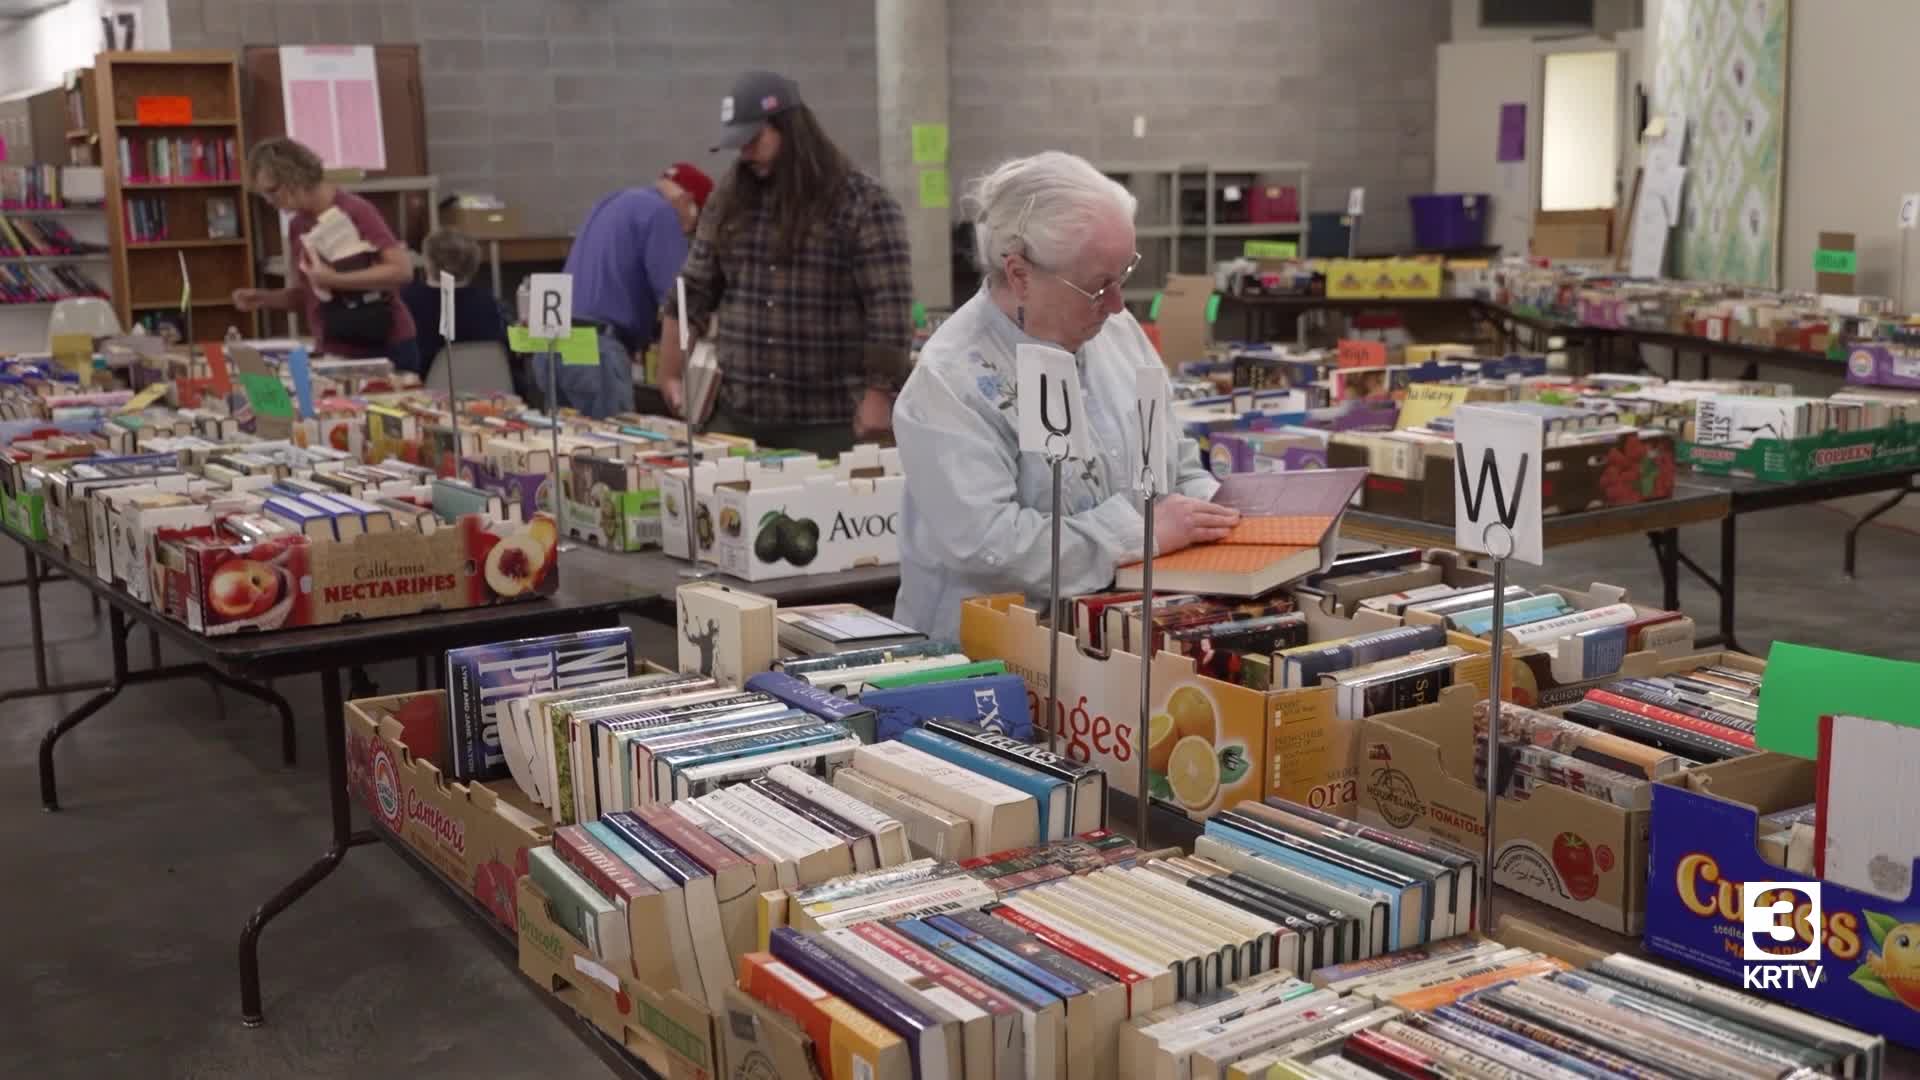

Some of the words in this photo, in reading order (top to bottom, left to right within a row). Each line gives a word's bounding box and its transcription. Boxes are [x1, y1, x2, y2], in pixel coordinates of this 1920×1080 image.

[542, 289, 563, 327] R
[1039, 372, 1073, 436] U
[1456, 441, 1530, 529] W
[323, 573, 457, 604] NECTARINES
[353, 560, 425, 581] California
[407, 787, 465, 857] Campari
